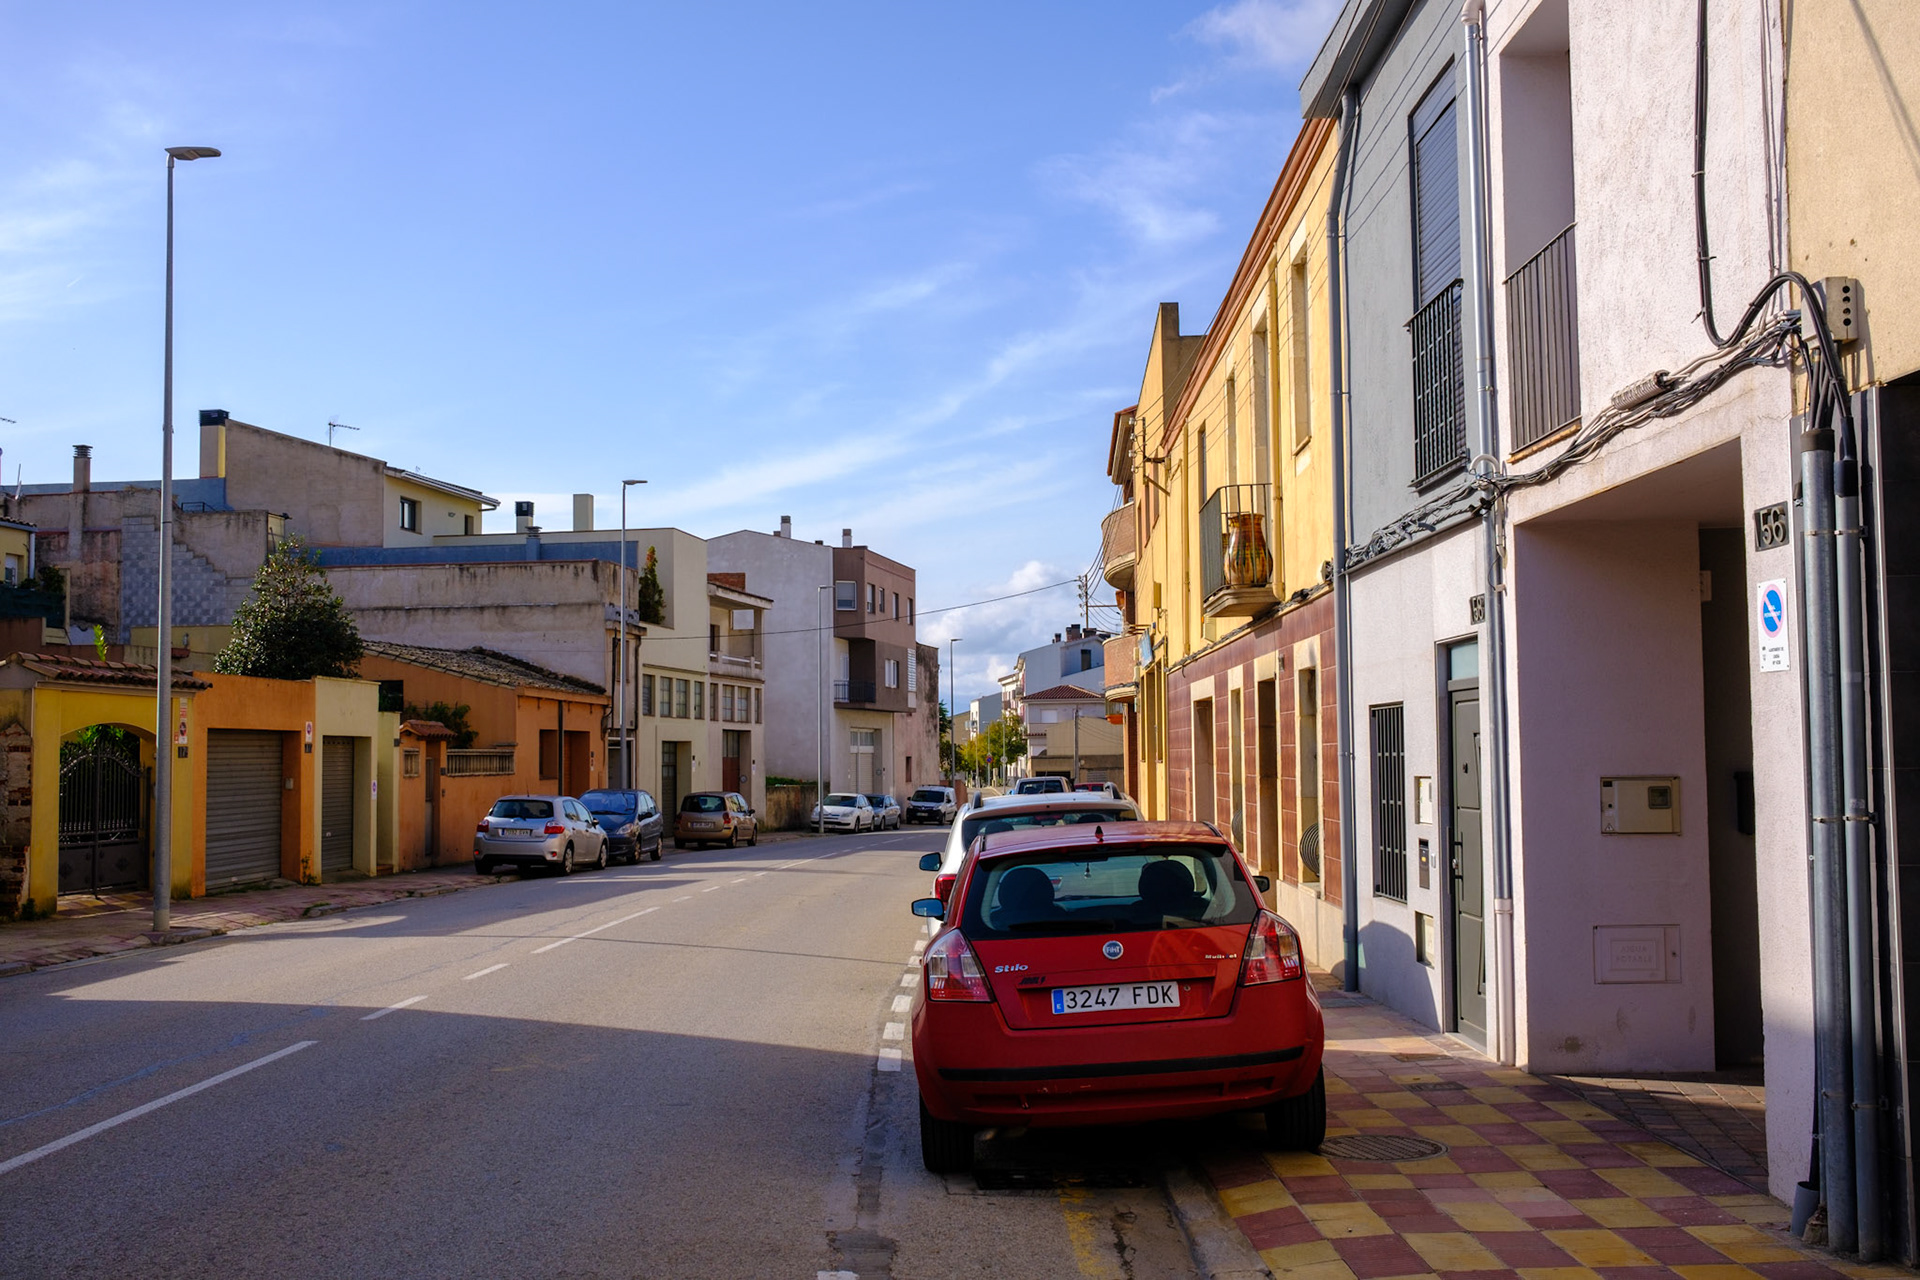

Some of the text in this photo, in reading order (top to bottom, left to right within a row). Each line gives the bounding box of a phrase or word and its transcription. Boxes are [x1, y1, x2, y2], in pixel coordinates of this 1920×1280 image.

[1759, 507, 1786, 545] 56
[1472, 596, 1484, 621] 58
[994, 963, 1028, 974] Stilo
[1065, 984, 1174, 1009] 3247 FDK
